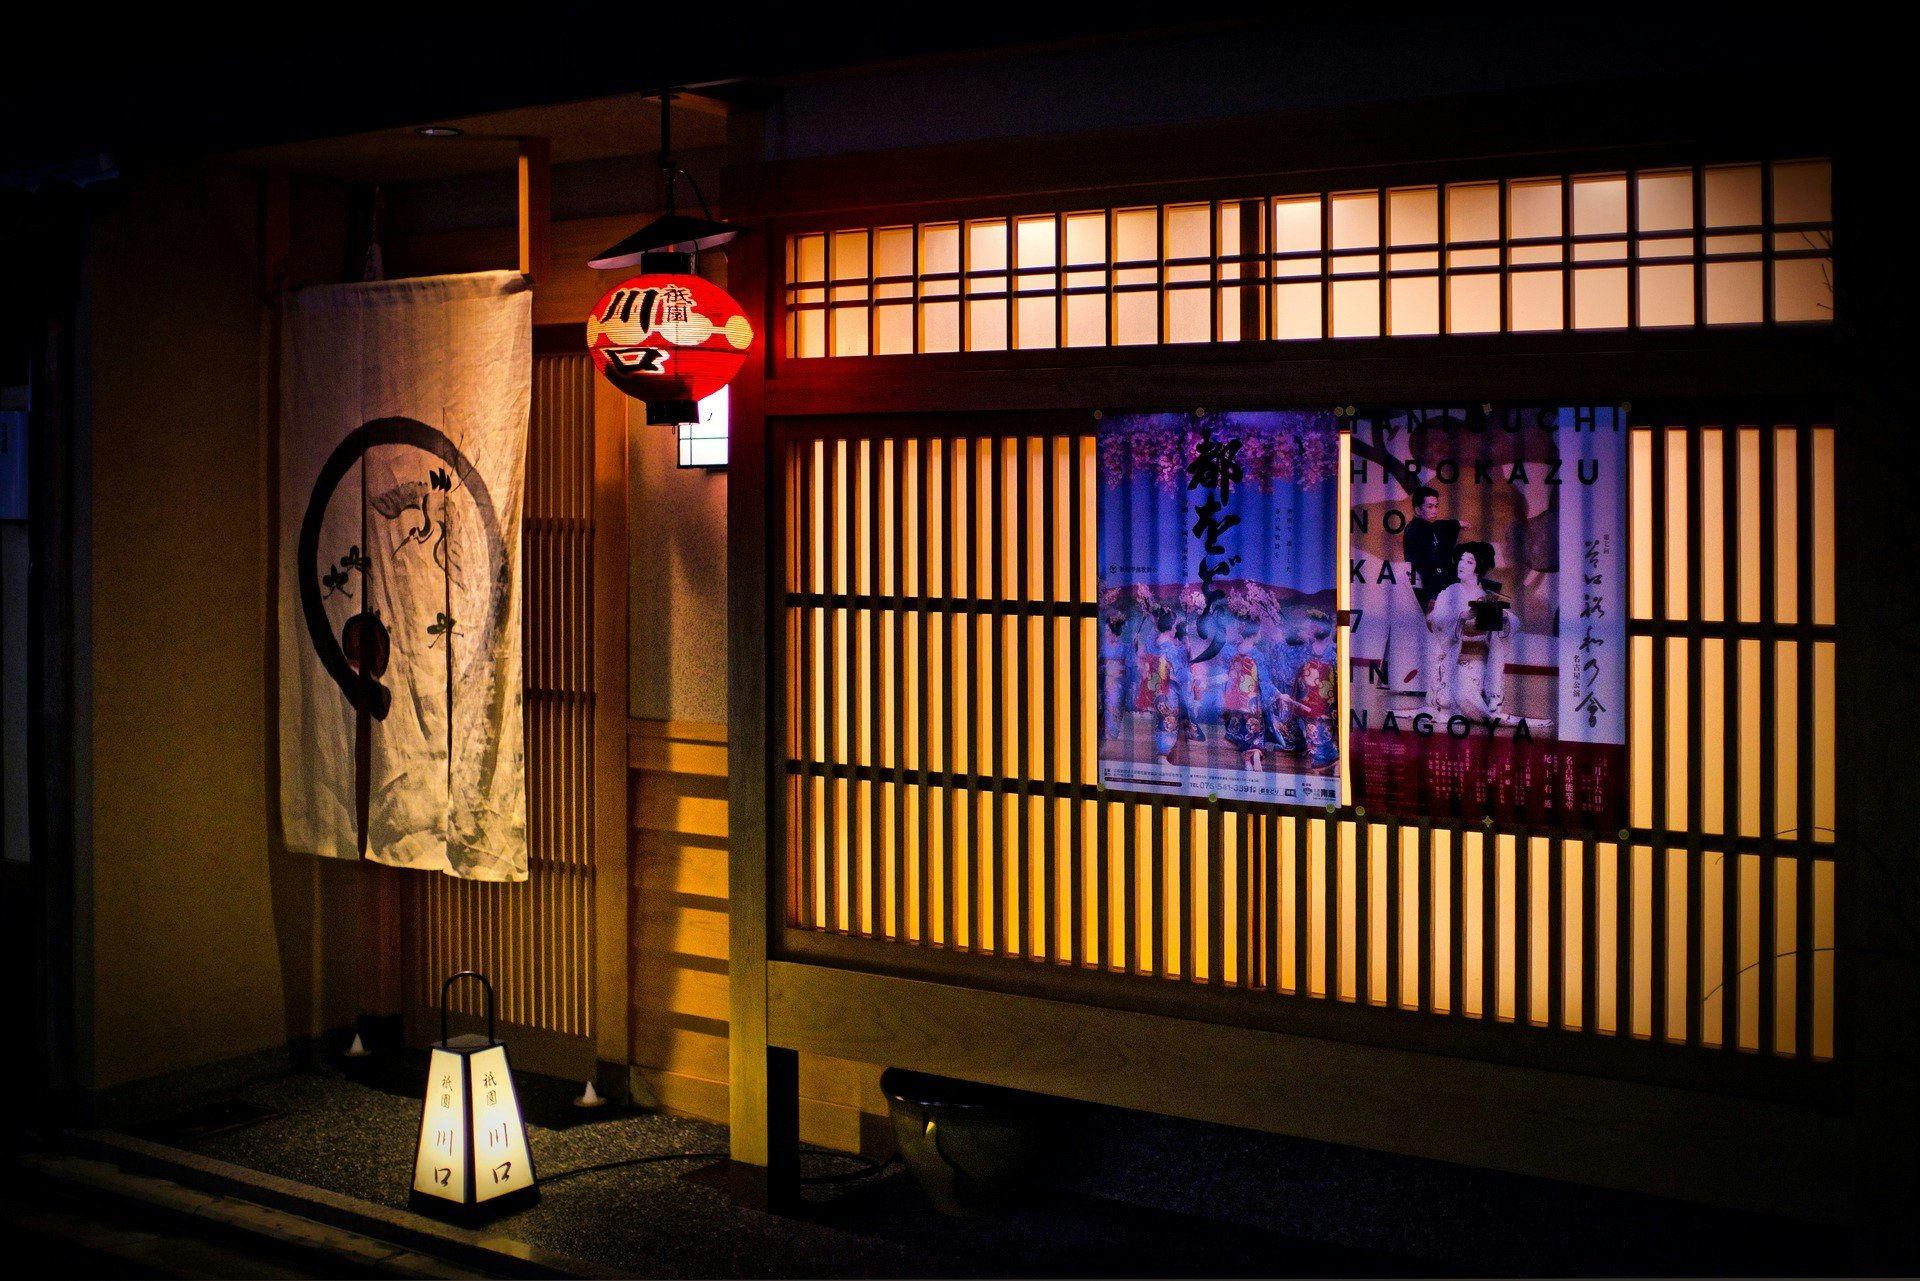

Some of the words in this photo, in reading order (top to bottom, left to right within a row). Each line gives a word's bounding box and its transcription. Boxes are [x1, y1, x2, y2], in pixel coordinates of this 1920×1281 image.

[600, 289, 663, 372] 川口
[1350, 459, 1599, 486] HIROKAZU
[1350, 509, 1406, 535] NO
[1350, 609, 1363, 633] 7
[1350, 708, 1533, 743] NAGOYA
[434, 1130, 453, 1187] 川口
[489, 1122, 512, 1185] 川口
